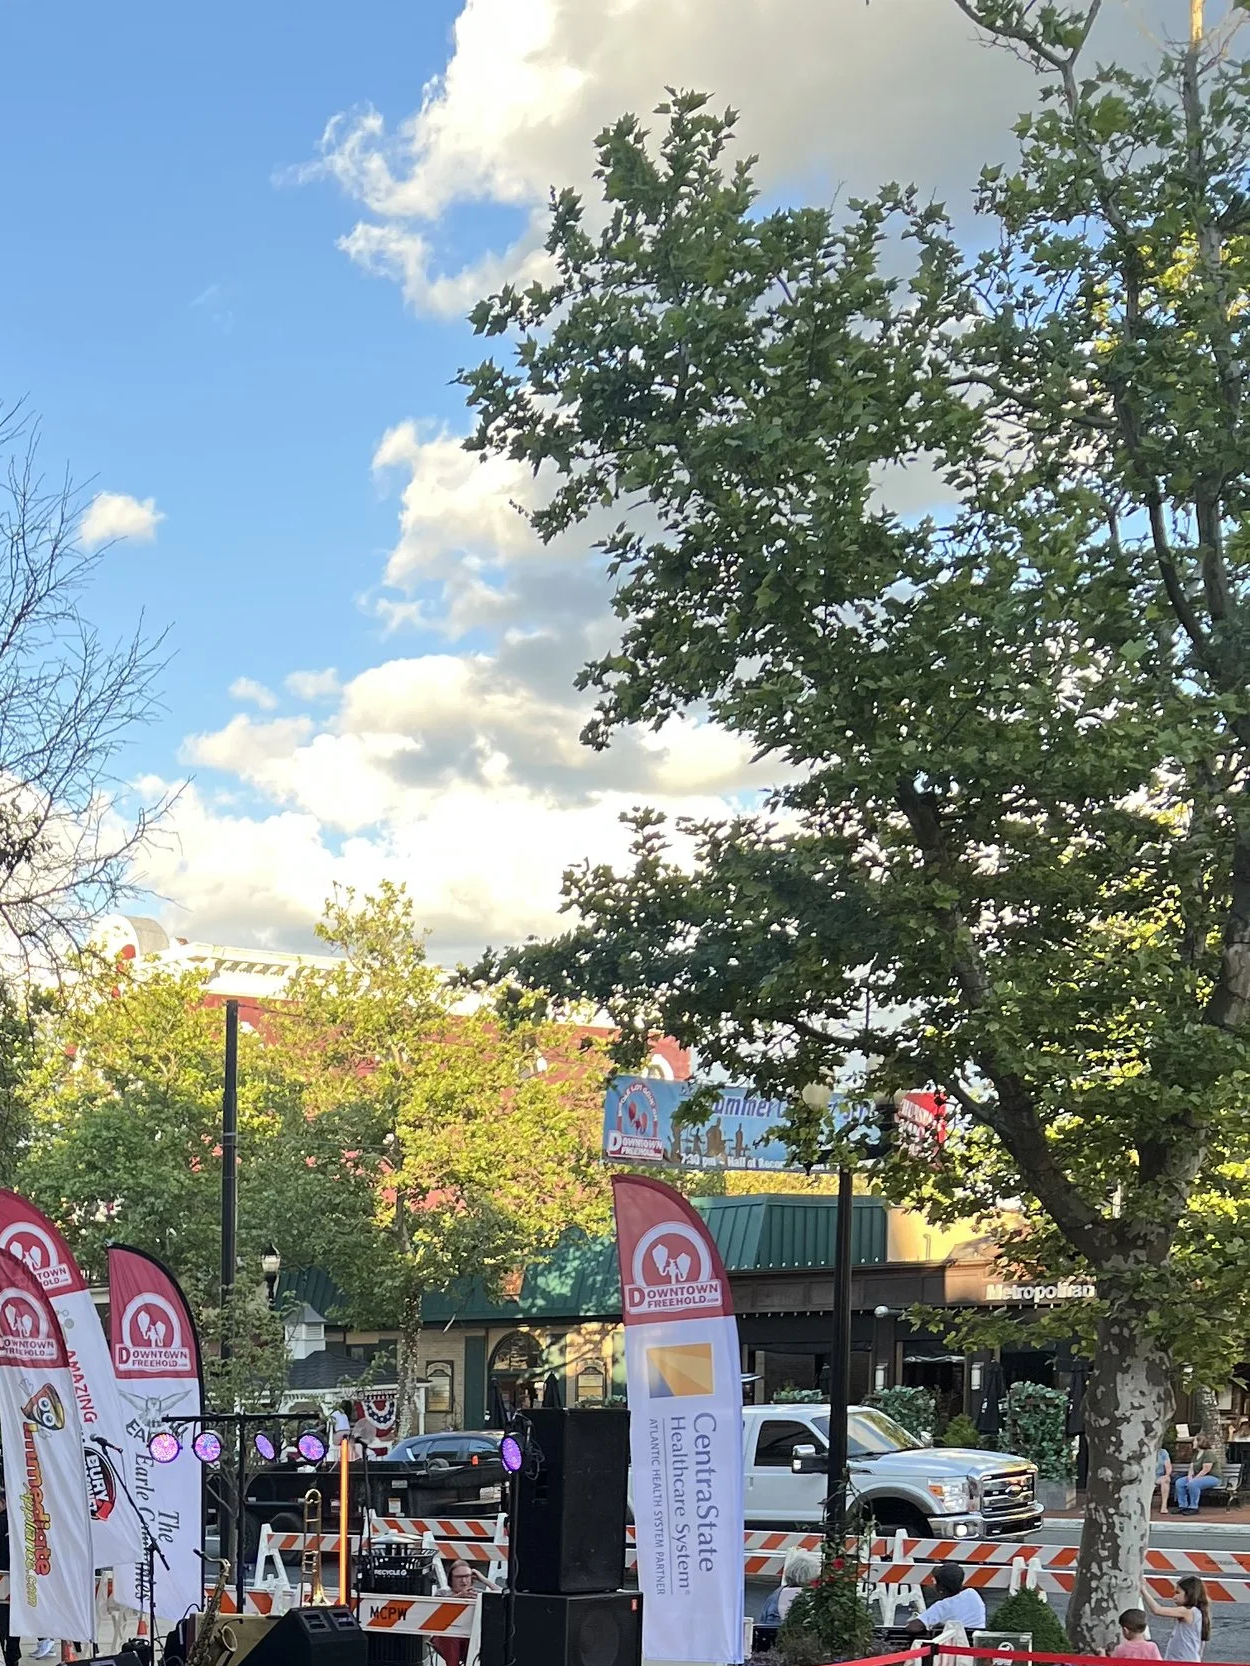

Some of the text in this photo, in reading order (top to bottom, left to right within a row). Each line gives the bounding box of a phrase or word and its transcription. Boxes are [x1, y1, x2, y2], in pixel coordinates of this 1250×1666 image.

[712, 1097, 774, 1117] ummer
[608, 1132, 663, 1152] DOWNTOWN
[758, 1157, 785, 1169] Recor
[628, 1283, 718, 1308] DOWNTOWN
[986, 1280, 1096, 1303] Metropolitan
[118, 1347, 188, 1365] DOWNTOWN
[67, 1350, 98, 1424] AMAZING
[134, 1452, 155, 1502] Earle
[671, 1416, 689, 1517] Healthcare
[23, 1421, 52, 1576] Immediate
[693, 1412, 719, 1573] CentraState
[649, 1418, 666, 1596] ATLANTIC HEALTH SYSTEM PARTNER
[158, 1511, 180, 1543] The
[374, 1569, 400, 1577] RECYCLE
[370, 1605, 408, 1621] MCPW
